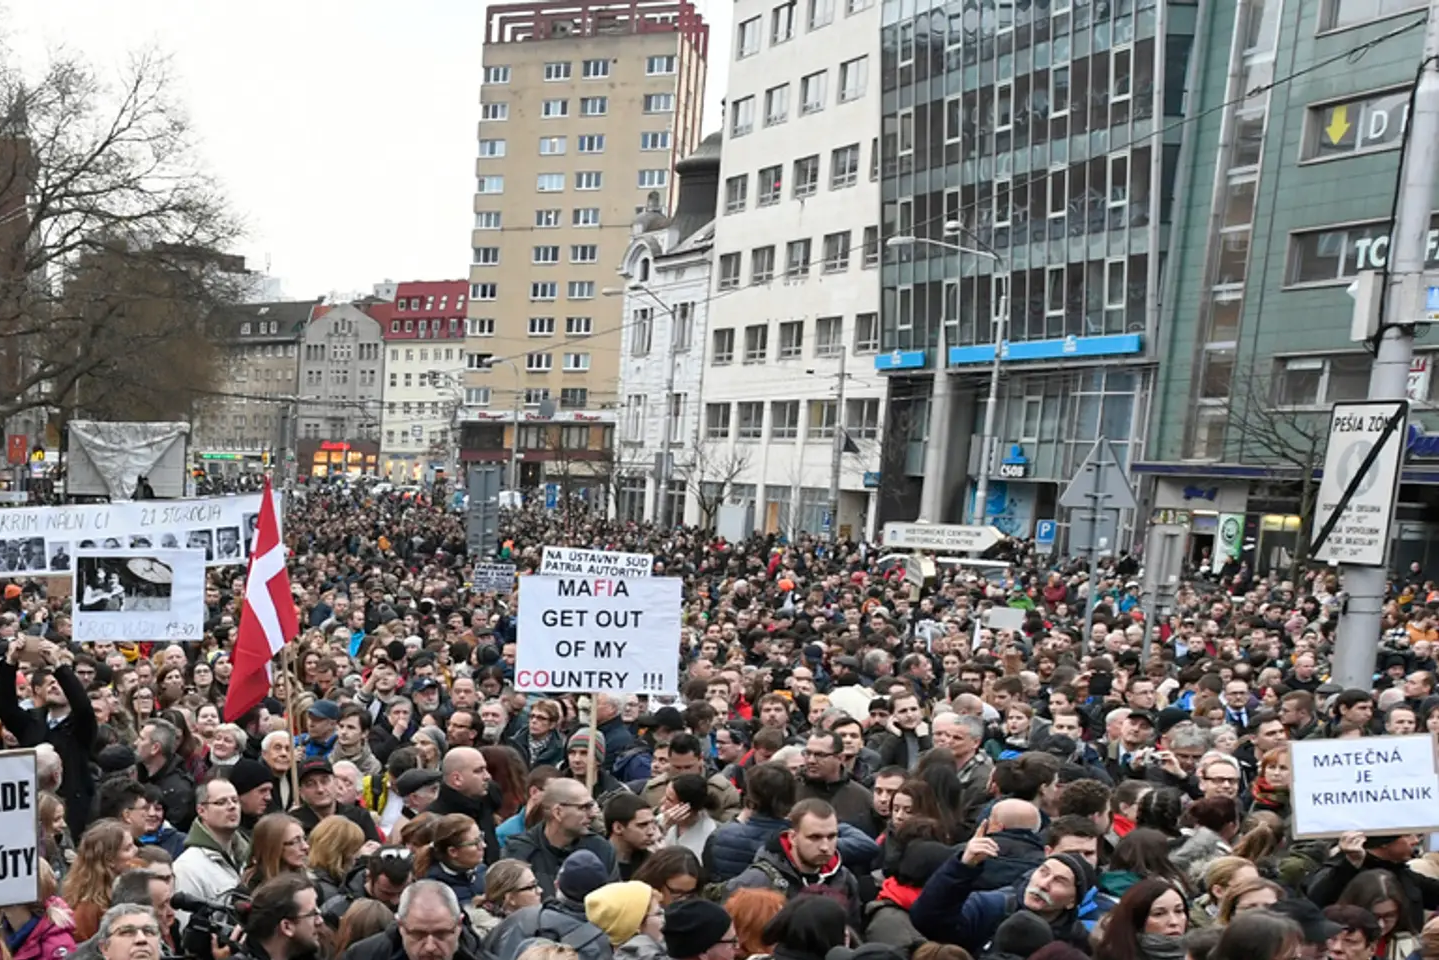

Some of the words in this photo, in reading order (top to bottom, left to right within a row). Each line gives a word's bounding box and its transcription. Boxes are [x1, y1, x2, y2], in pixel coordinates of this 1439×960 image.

[557, 579, 629, 598] MAFIA
[541, 610, 588, 627] GET
[595, 610, 643, 628] OUT
[555, 641, 586, 658] OF
[594, 641, 628, 658] MY
[517, 670, 629, 688] COUNTRY
[1313, 746, 1403, 768] MATEČNÁ
[1355, 769, 1373, 783] JE
[1312, 785, 1432, 806] KRIMINÁLNIK
